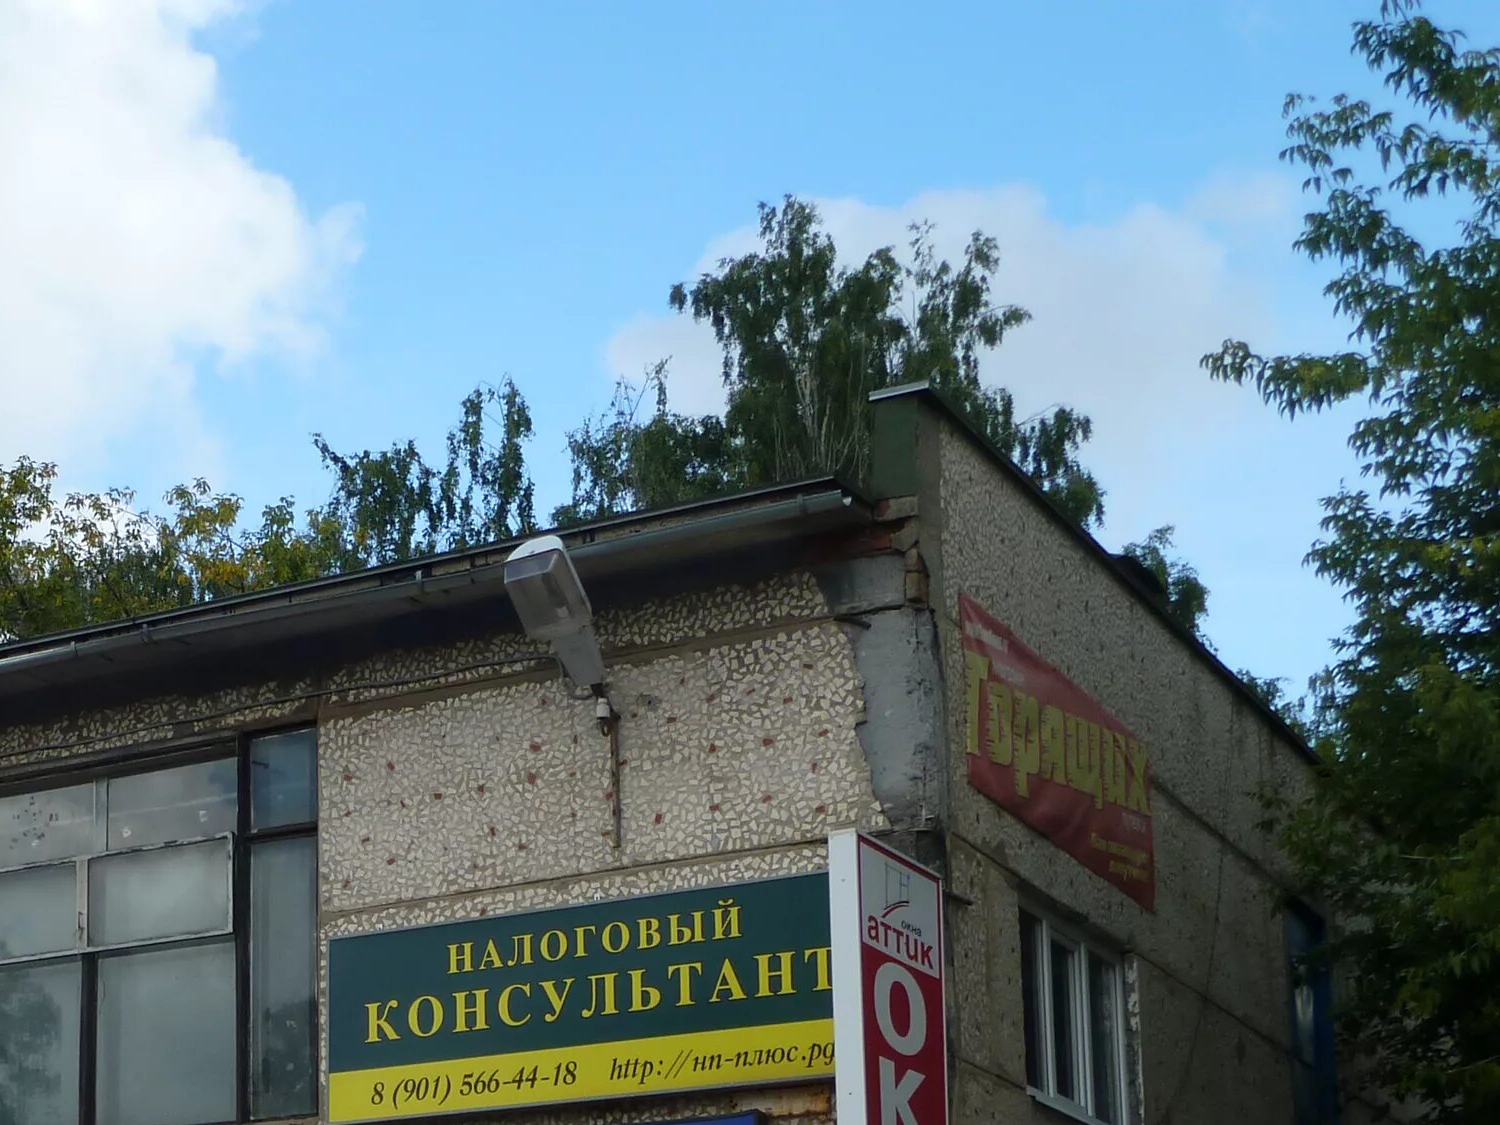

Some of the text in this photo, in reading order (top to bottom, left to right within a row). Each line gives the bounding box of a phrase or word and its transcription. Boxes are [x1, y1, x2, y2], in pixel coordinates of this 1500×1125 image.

[965, 650, 1152, 817] Горящих
[446, 898, 743, 974] НАЛОГОВЫЙ
[364, 945, 834, 1044] КОНСУЛЬТАНТ
[371, 1080, 385, 1105] 8
[392, 1073, 451, 1110] (901)
[458, 1061, 578, 1097] 566-44-18
